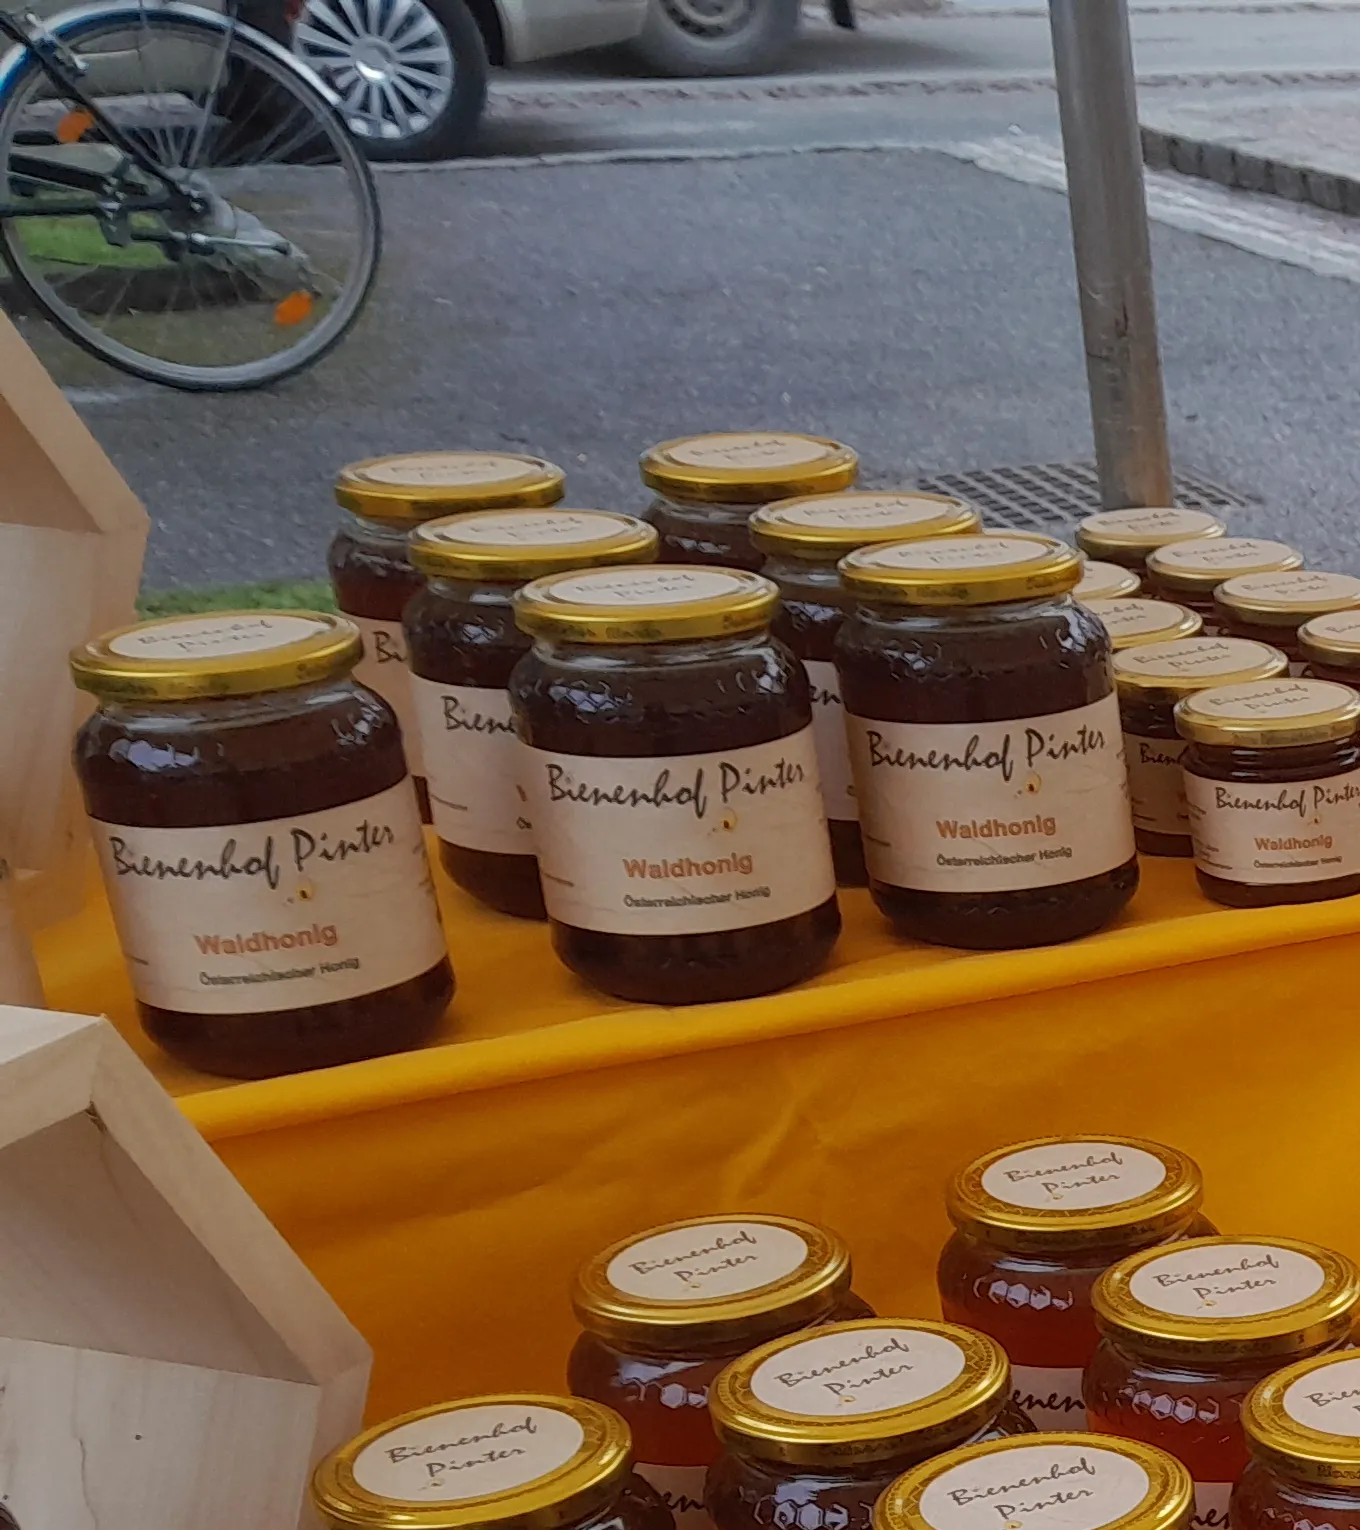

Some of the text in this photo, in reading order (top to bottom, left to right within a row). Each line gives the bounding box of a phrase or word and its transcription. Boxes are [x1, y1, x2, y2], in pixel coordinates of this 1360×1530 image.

[866, 730, 1013, 781] Bienenhof
[1025, 724, 1105, 767] Pinter
[545, 757, 804, 818] Bienenhof Pinter
[1215, 783, 1360, 817] Bienenhof Pinter
[937, 815, 1056, 838] Waldhonig
[1254, 834, 1333, 851] Waldhonig
[108, 819, 395, 890] Bienenhof Pinter
[623, 853, 753, 878] Waldhonig
[194, 923, 340, 956] Waldhonig
[1003, 1153, 1124, 1185] Bienenhof
[1040, 1169, 1123, 1194] Pinter
[629, 1231, 758, 1276] Bienenhof
[674, 1253, 758, 1284] Pinter
[1152, 1253, 1281, 1288] Bienenhof
[1192, 1275, 1279, 1301] Pinter
[774, 1339, 911, 1389] Bienenhof
[824, 1361, 914, 1397] Pinter
[385, 1416, 537, 1466] Bienenhof
[426, 1446, 527, 1478] Pinter
[948, 1458, 1096, 1507] Bienenhof
[996, 1486, 1094, 1521] Pinter
